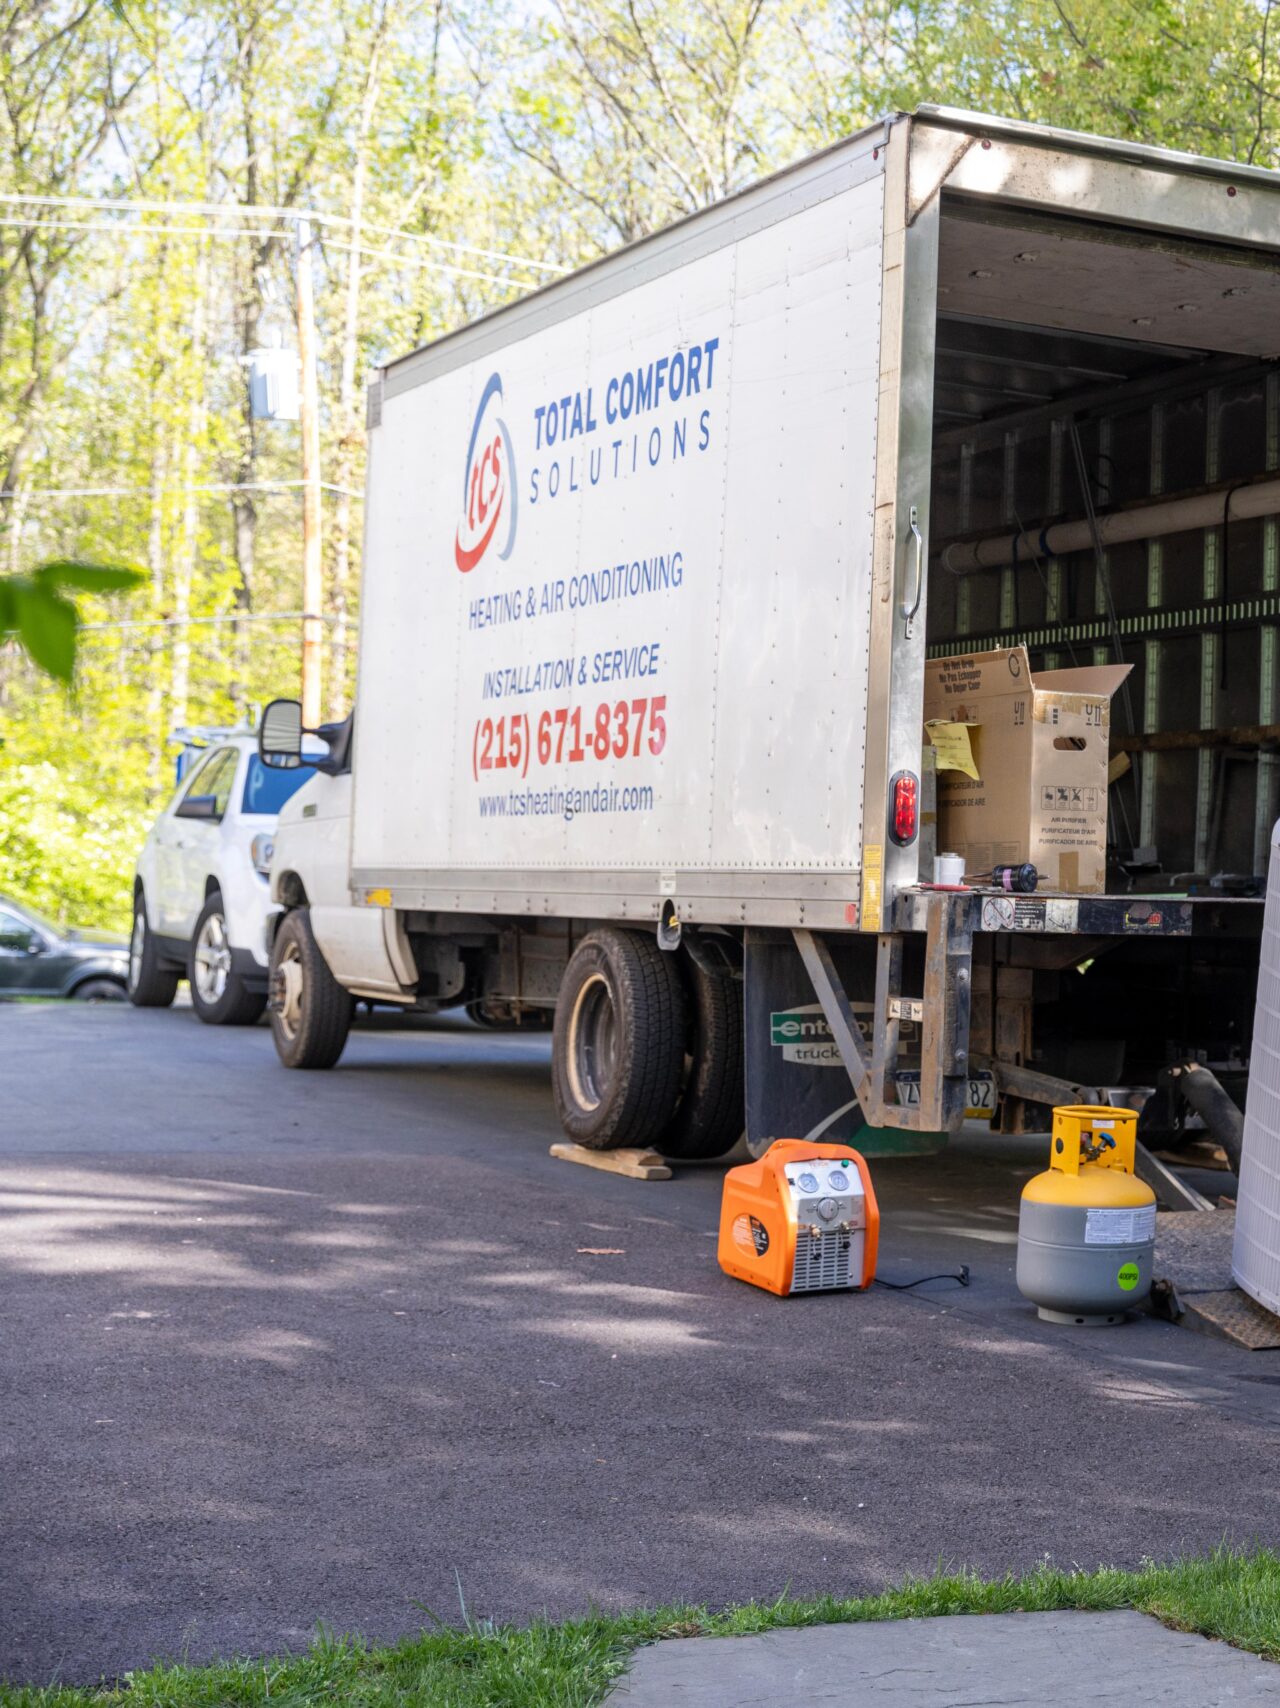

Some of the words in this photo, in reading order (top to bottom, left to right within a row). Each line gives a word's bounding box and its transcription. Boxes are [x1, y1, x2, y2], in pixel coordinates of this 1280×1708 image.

[534, 388, 597, 450] TOTAL
[605, 337, 720, 425] COMFORT
[529, 410, 711, 504] SOLUTIONS
[468, 589, 522, 631] HEATING
[525, 587, 536, 619] &
[540, 582, 565, 616] AIR
[568, 552, 684, 610] CONDITIONING
[482, 657, 574, 700] INSTALLATION
[577, 655, 588, 685] &
[592, 643, 661, 682] SERVICE
[472, 713, 530, 782] (215)
[537, 695, 668, 766] 671-8375
[479, 781, 654, 821] www.tcsheatingandair.com
